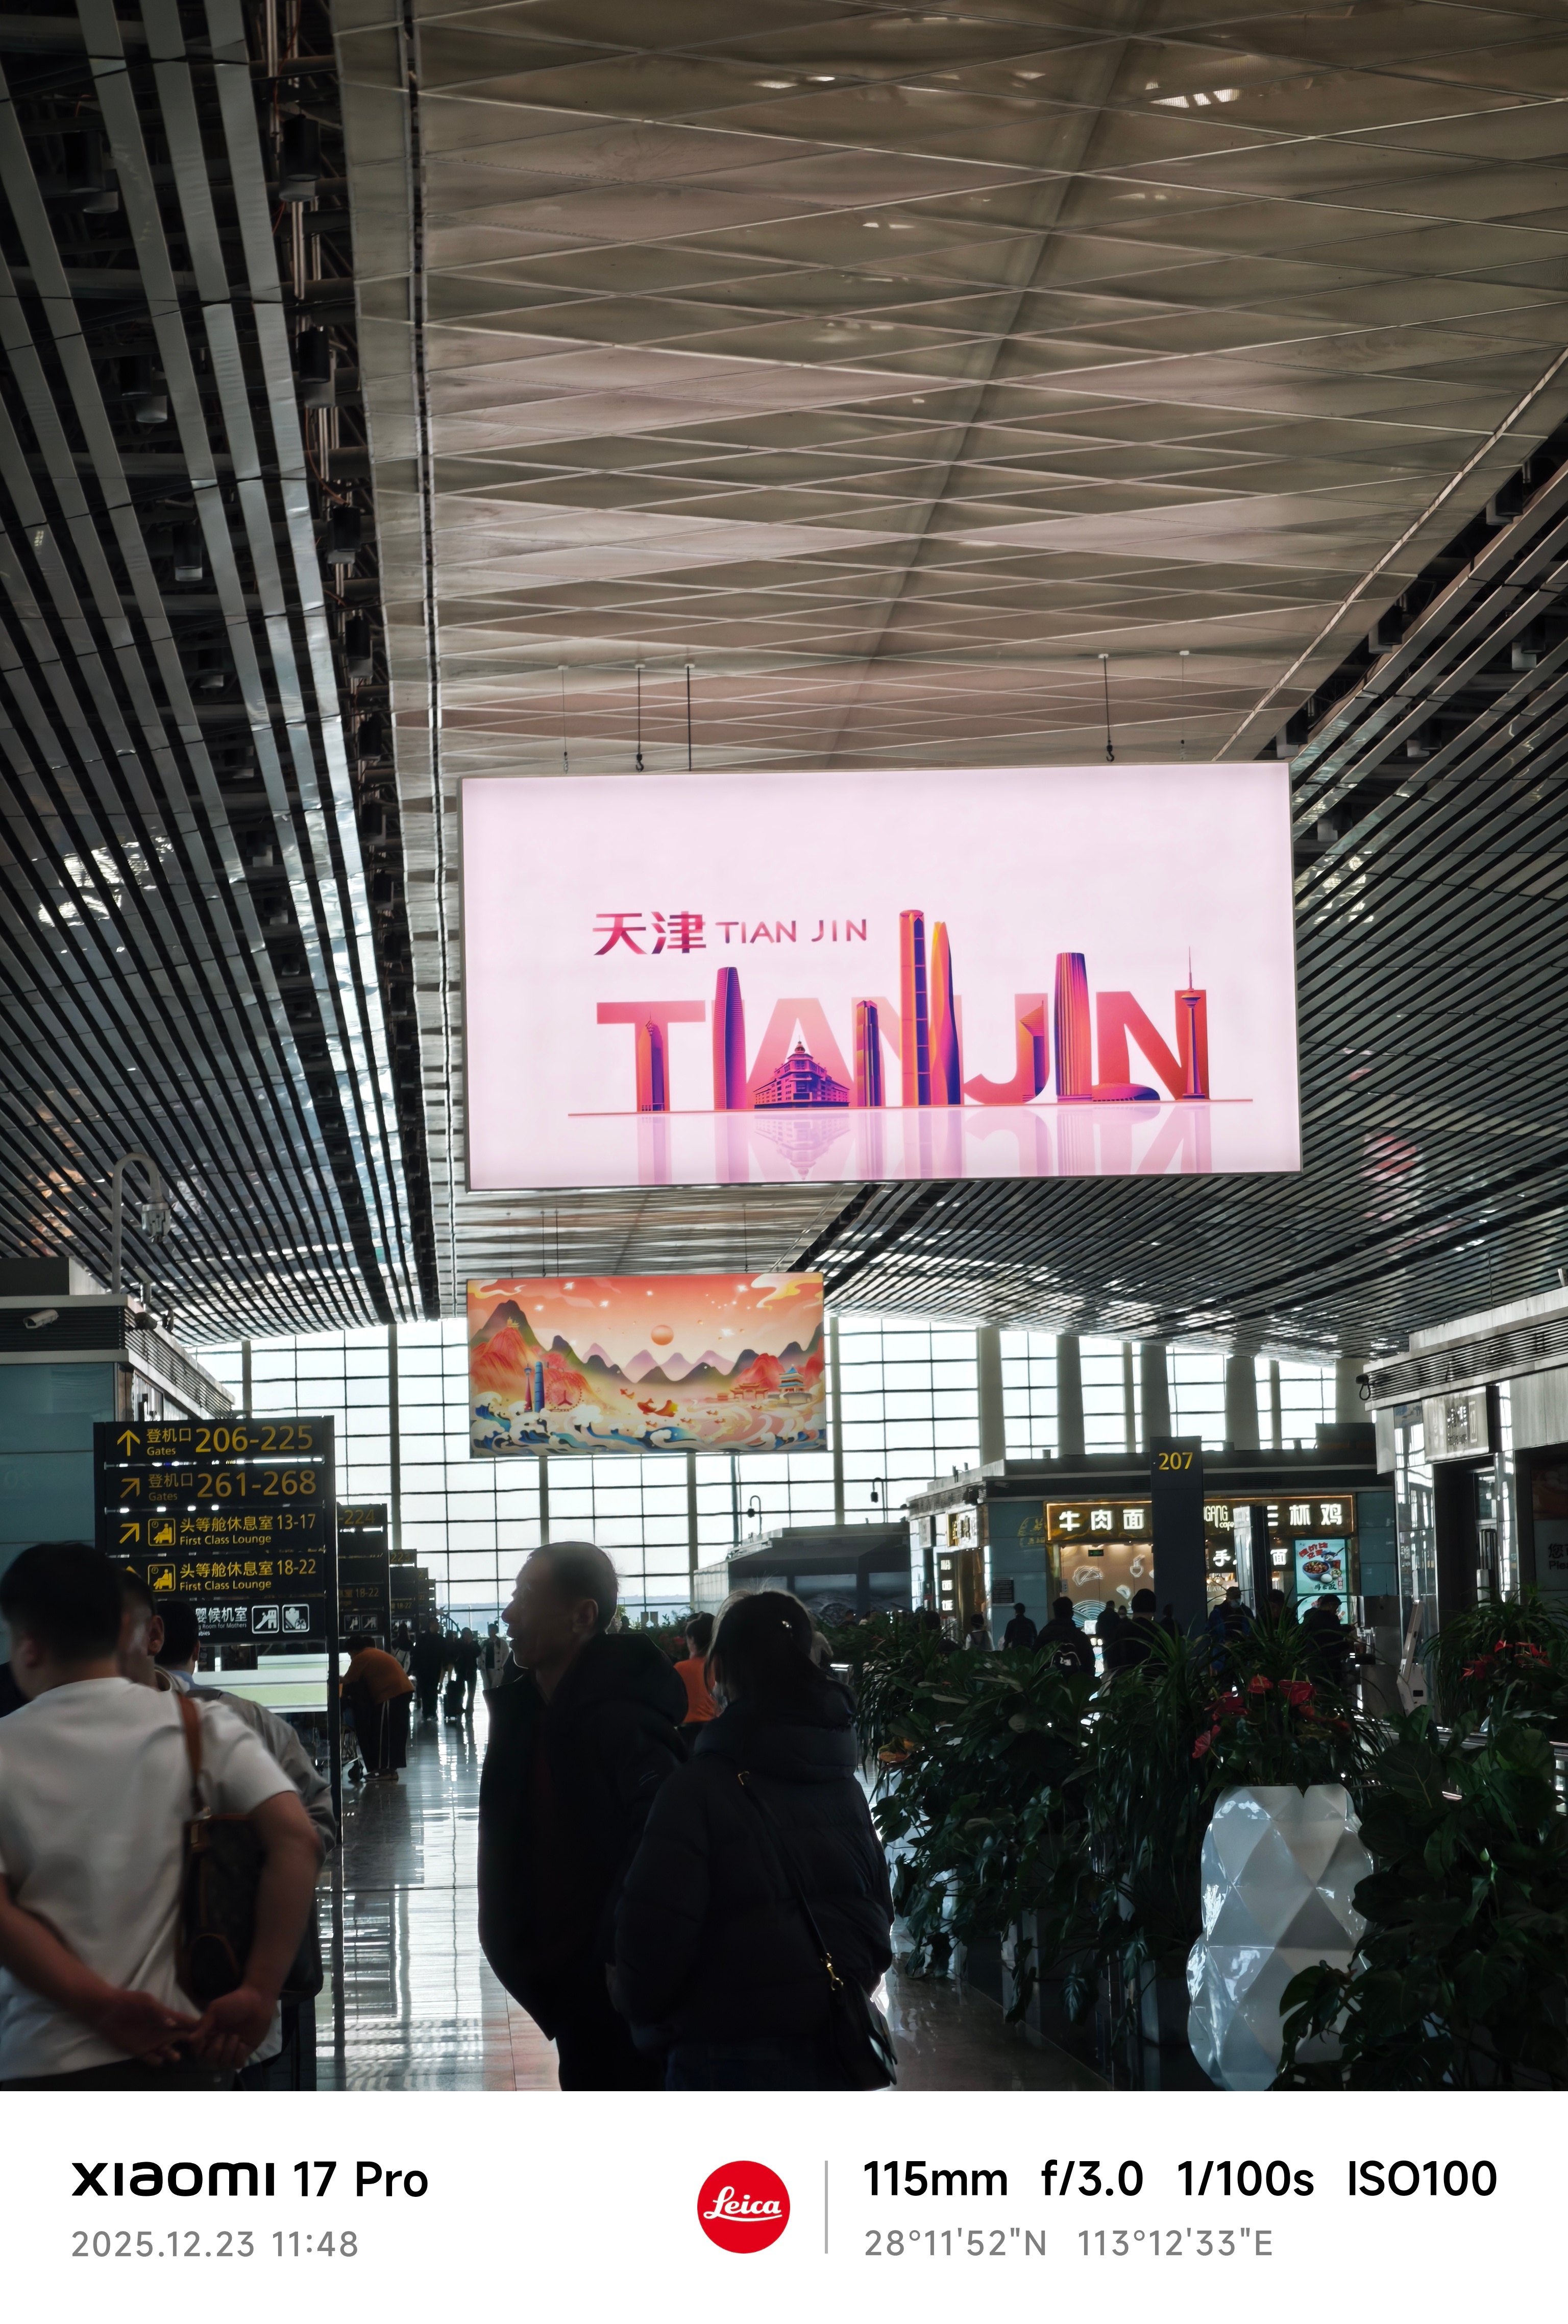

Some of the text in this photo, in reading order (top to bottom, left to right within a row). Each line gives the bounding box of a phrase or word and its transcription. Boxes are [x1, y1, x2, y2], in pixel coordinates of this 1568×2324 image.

[593, 911, 707, 955] 天津
[715, 919, 867, 944] TIAN JIN
[146, 1425, 313, 1453] 登机口 206-225
[147, 1446, 176, 1456] Gates
[1158, 1452, 1193, 1470] 207
[149, 1470, 316, 1497] 登机口 261-268
[149, 1492, 178, 1501] Gates
[180, 1514, 315, 1533] 头等舱休息室 13-17
[1059, 1509, 1145, 1531] 牛肉面
[180, 1534, 272, 1546] First Class Lounge
[180, 1559, 316, 1578] 头等舱休息室 18-22
[180, 1580, 272, 1591] First Class Lounge
